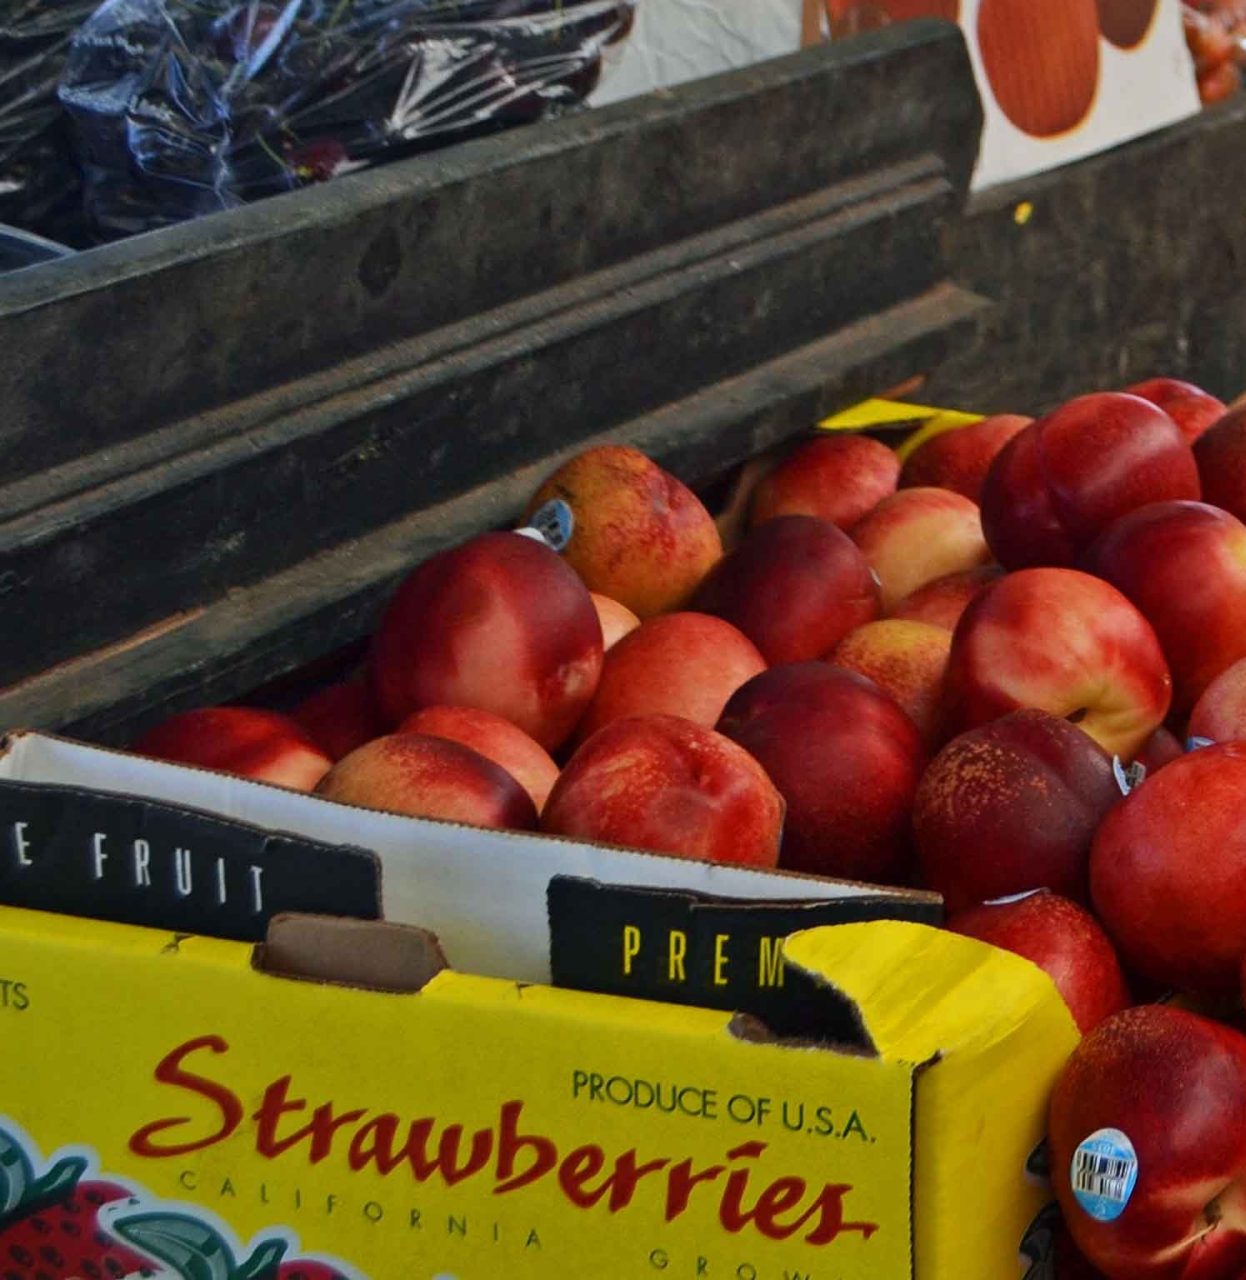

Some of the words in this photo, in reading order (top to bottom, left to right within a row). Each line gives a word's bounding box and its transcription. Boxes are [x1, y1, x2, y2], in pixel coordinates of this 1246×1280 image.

[94, 832, 264, 912] FRUIT
[622, 925, 785, 988] PREM
[128, 1034, 880, 1246] Strawberries
[572, 1070, 717, 1119] PRODUCE
[727, 1095, 771, 1122] OF
[782, 1102, 876, 1144] U.S.A.
[179, 1169, 541, 1249] CALIFORNIA
